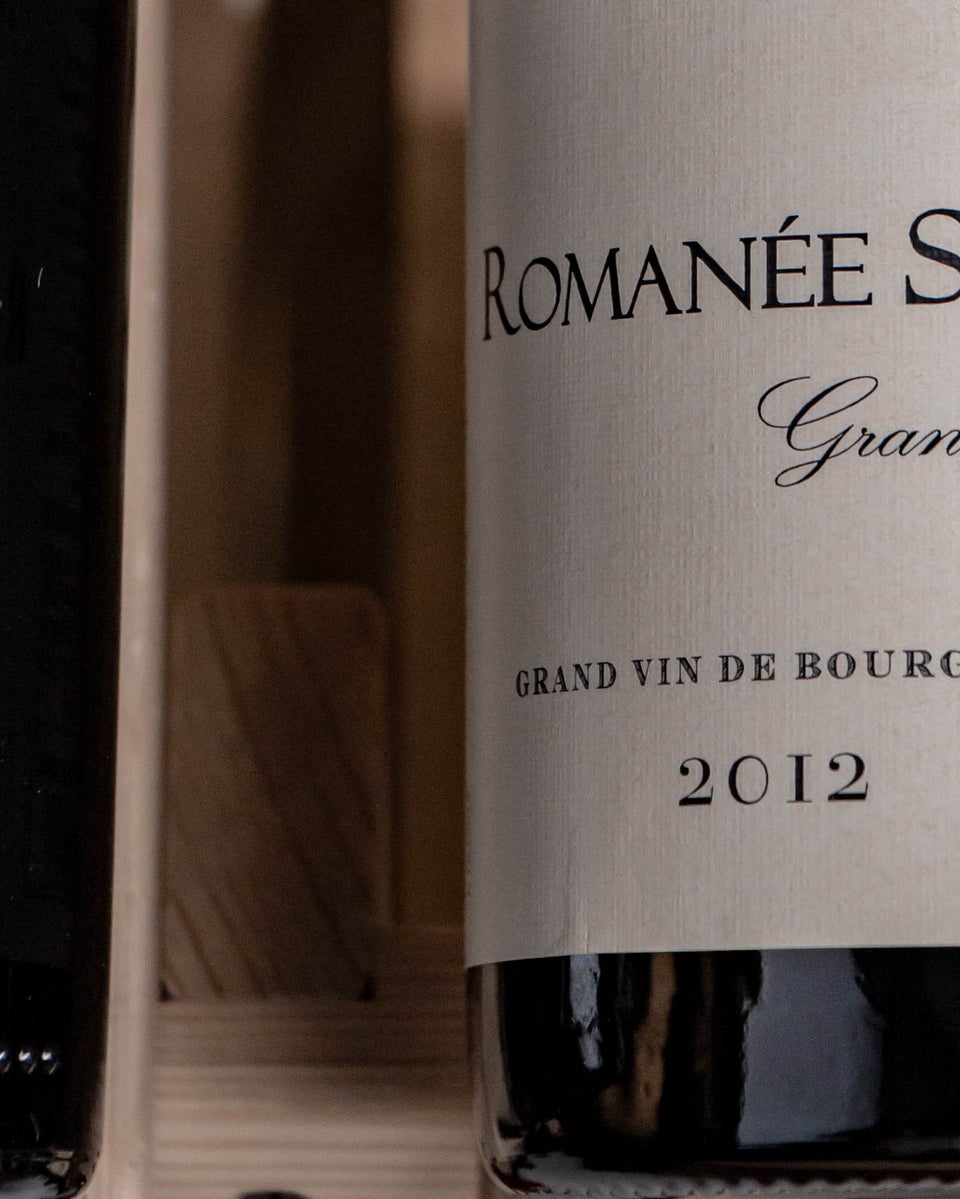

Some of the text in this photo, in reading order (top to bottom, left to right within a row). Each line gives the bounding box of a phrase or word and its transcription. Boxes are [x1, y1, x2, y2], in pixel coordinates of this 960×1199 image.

[483, 213, 874, 342] ROMANÉE
[515, 660, 618, 699] GRAND
[631, 655, 703, 687] VIN
[718, 652, 777, 683] DE
[678, 751, 870, 807] 2012
